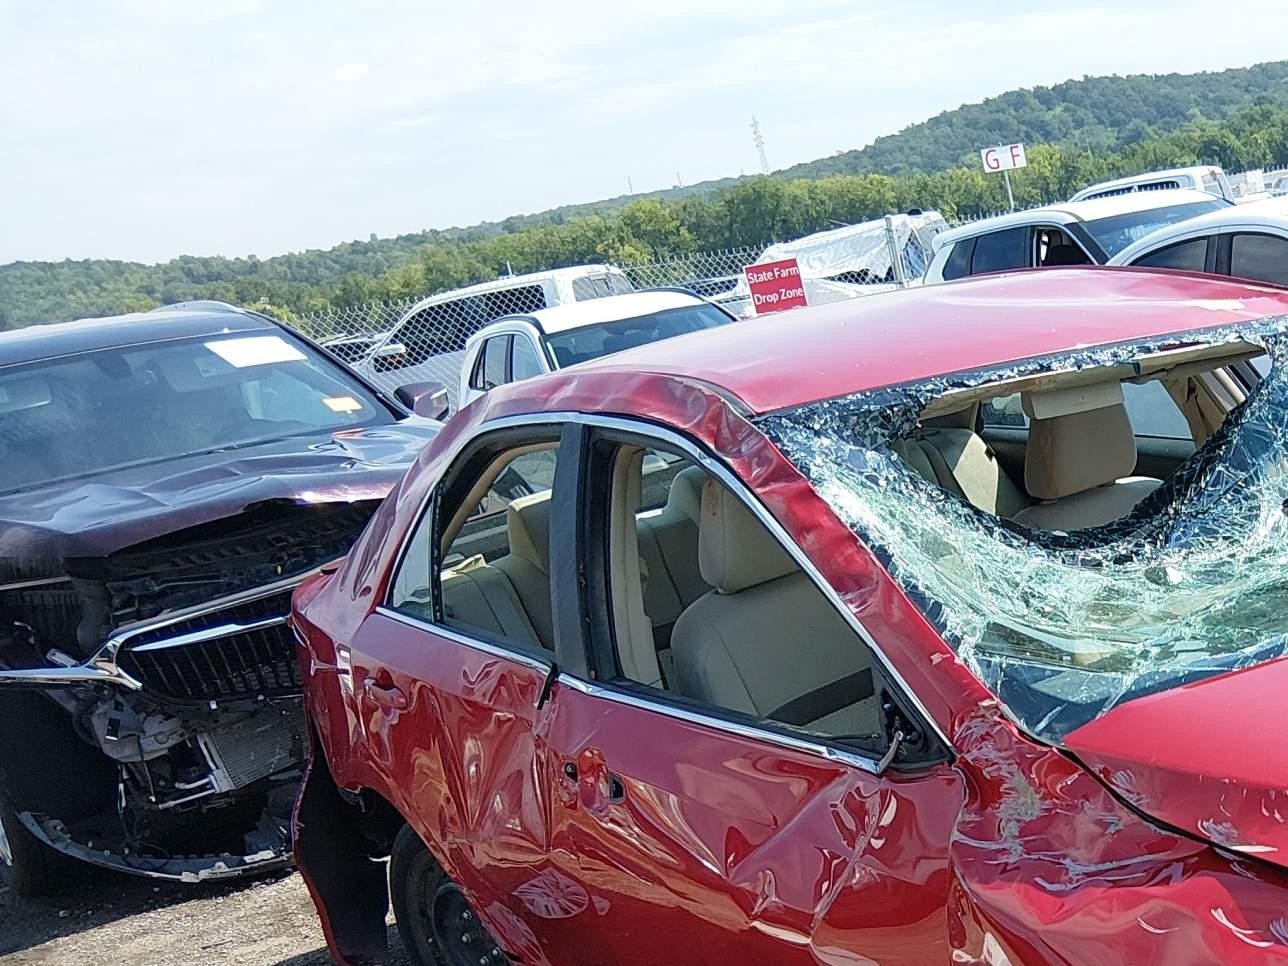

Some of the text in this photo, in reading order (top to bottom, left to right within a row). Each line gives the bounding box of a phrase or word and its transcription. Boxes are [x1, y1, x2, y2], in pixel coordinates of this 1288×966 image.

[985, 145, 1020, 170] G F
[747, 266, 800, 284] State Farm
[754, 287, 804, 306] Drop Zone
